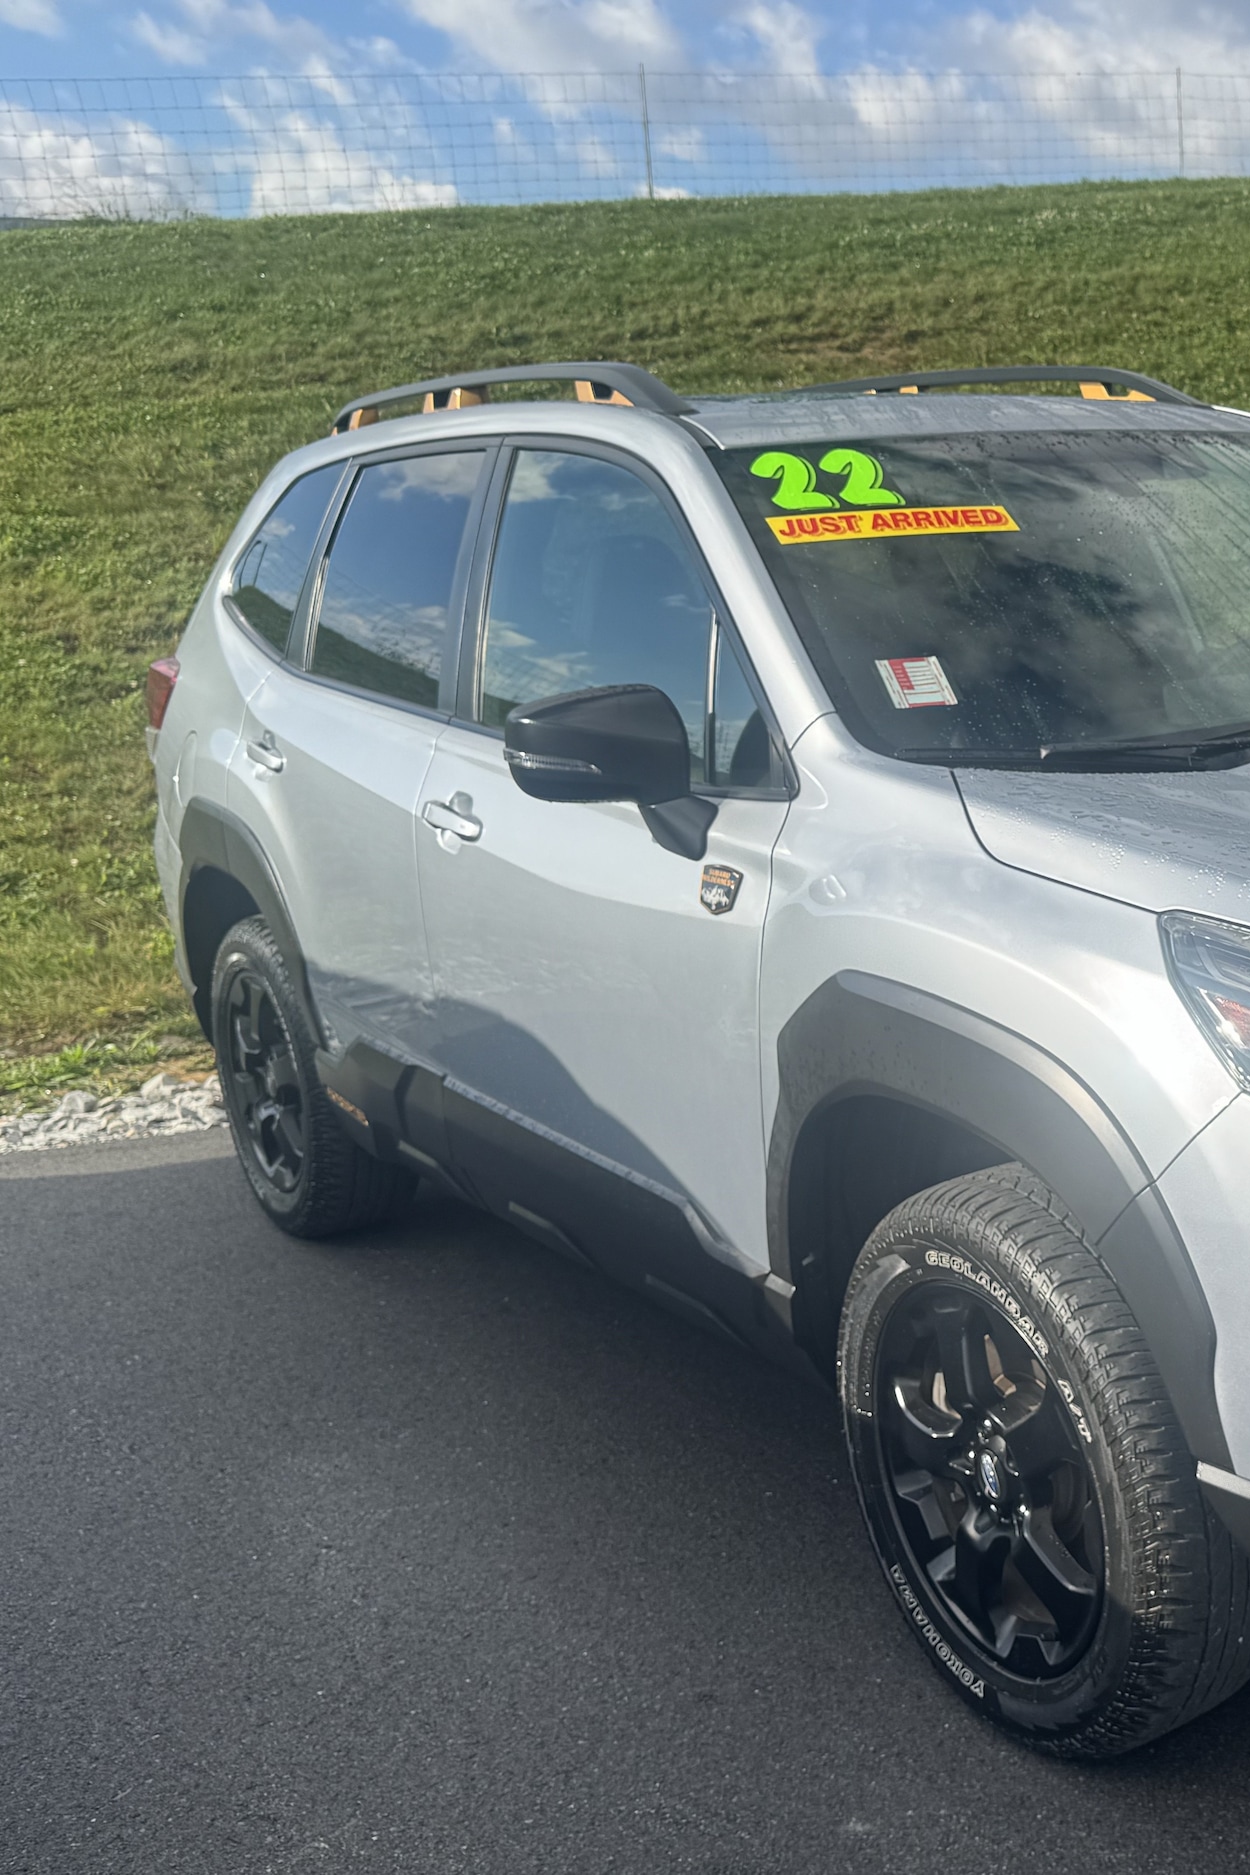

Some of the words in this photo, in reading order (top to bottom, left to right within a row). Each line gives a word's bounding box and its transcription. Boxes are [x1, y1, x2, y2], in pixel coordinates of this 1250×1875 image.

[750, 448, 905, 510] 22
[779, 514, 863, 539] JUST
[871, 508, 1009, 532] ARRIVED
[925, 1250, 1049, 1358] GEOLANDAR
[890, 1564, 985, 1698] YOKOHAMA
